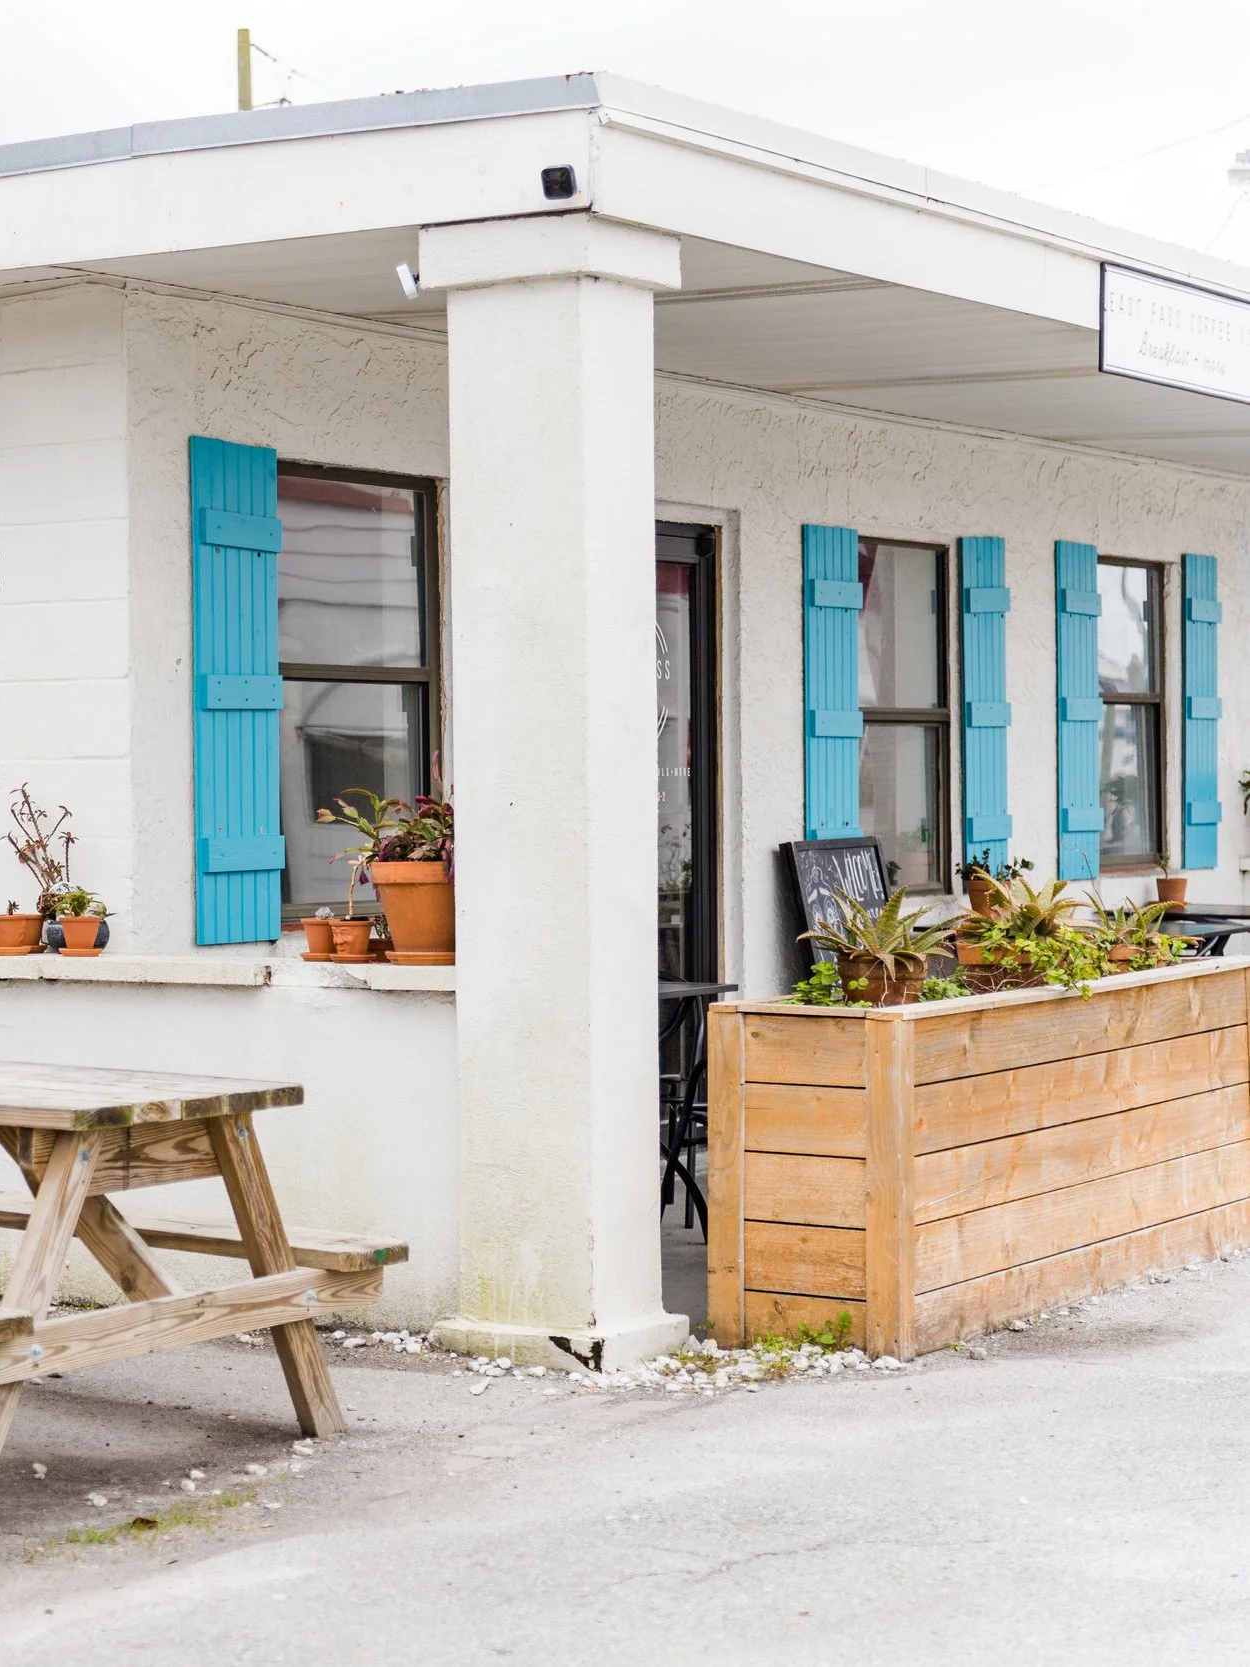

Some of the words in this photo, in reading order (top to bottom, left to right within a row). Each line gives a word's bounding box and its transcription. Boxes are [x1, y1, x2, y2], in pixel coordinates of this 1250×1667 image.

[1109, 291, 1143, 320] EAST
[1151, 303, 1182, 329] PASS
[1190, 313, 1232, 343] COFFEE
[1138, 330, 1191, 367] Breakfast
